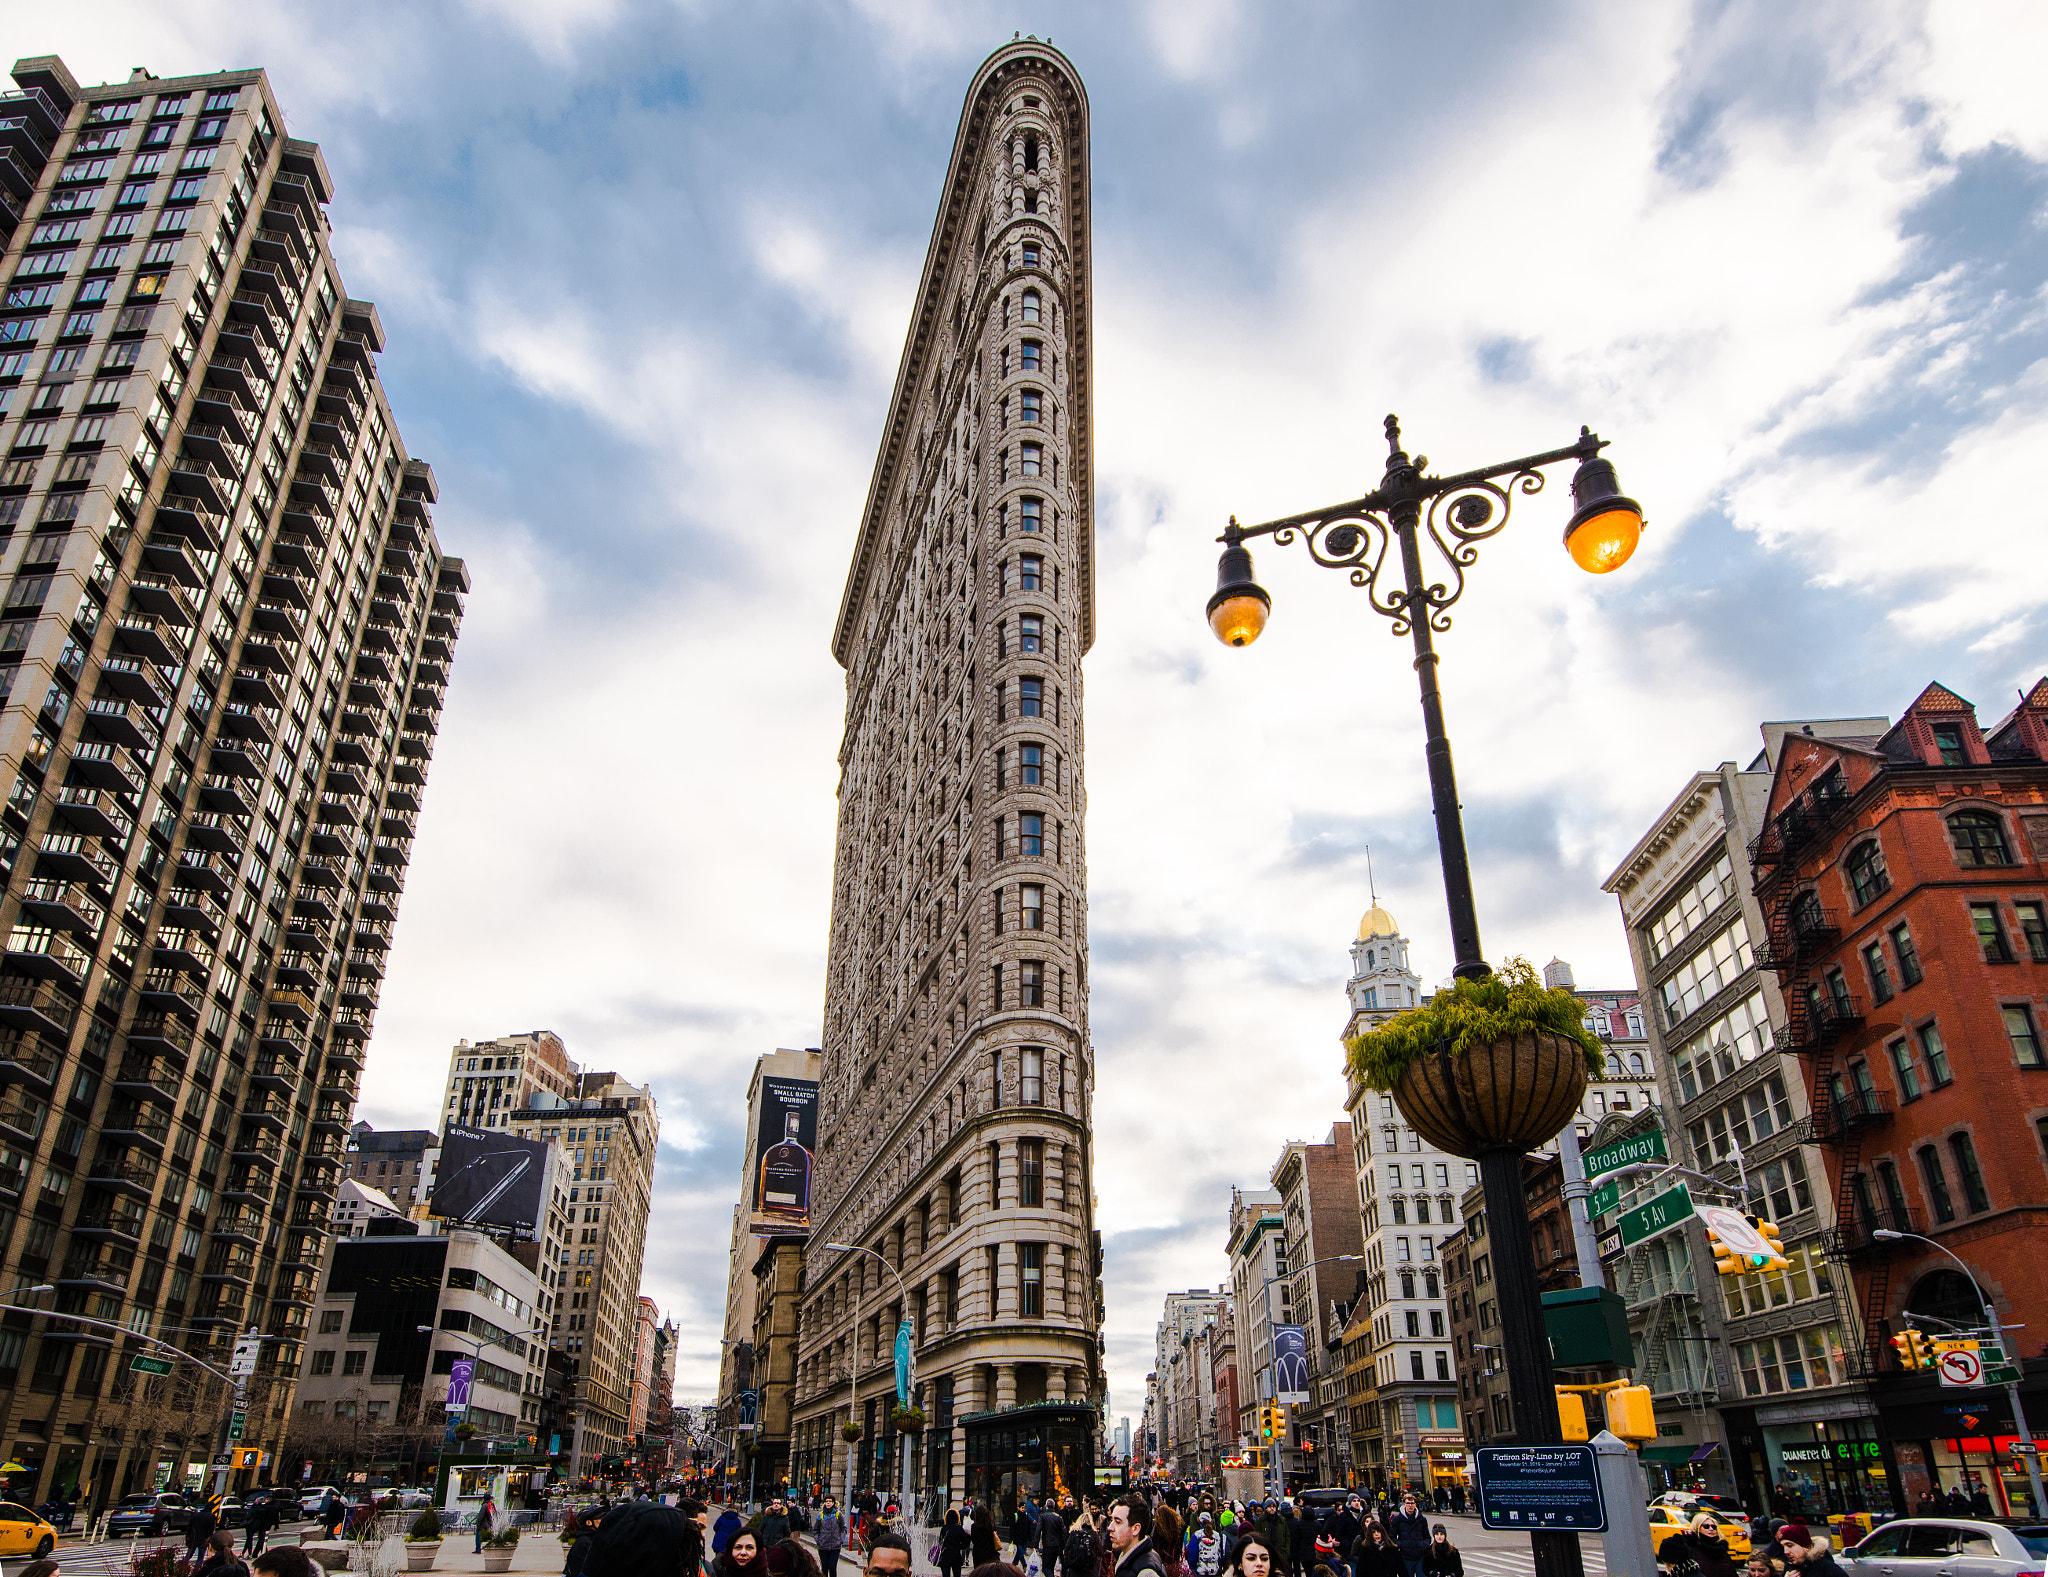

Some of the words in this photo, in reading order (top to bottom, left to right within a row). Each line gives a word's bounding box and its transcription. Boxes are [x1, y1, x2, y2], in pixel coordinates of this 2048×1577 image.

[779, 1096, 808, 1105] BOURBON
[456, 1129, 480, 1140] iPhone
[1588, 1137, 1655, 1172] Broadway
[1594, 1195, 1601, 1213] 5
[1602, 1191, 1609, 1203] Av
[1640, 1211, 1650, 1231] 5
[1651, 1205, 1666, 1227] Av
[1603, 1236, 1617, 1254] WAY
[140, 1359, 164, 1374] Broadway
[1990, 1372, 2002, 1382] Av
[1492, 1453, 1520, 1461] Flatiron
[1521, 1453, 1553, 1462] Sky-Line
[1554, 1452, 1564, 1462] by
[1565, 1452, 1581, 1460] LOT
[1544, 1512, 1556, 1520] LOT
